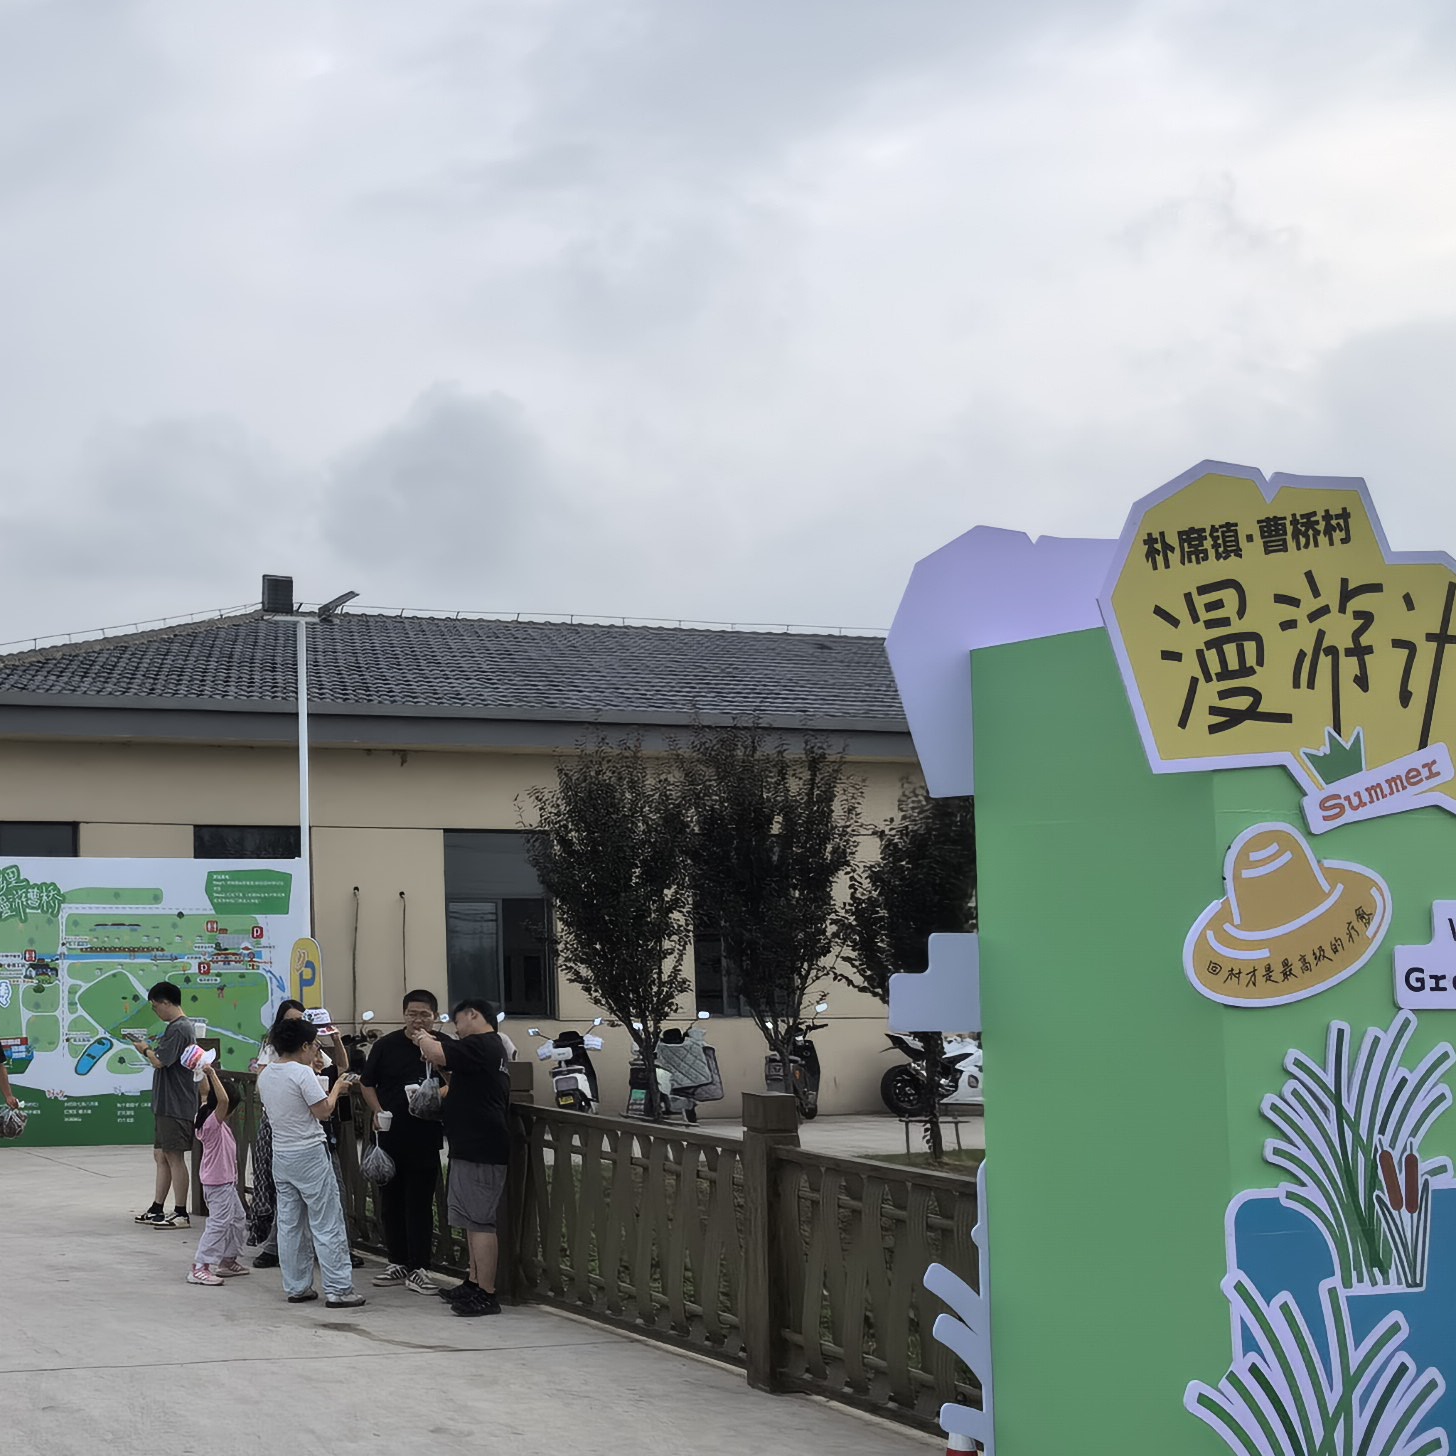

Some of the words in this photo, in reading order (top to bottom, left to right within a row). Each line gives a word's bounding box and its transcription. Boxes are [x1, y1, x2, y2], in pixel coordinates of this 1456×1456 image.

[1142, 506, 1352, 571] 朴席镇·曹桥村
[1317, 756, 1442, 823] Summer
